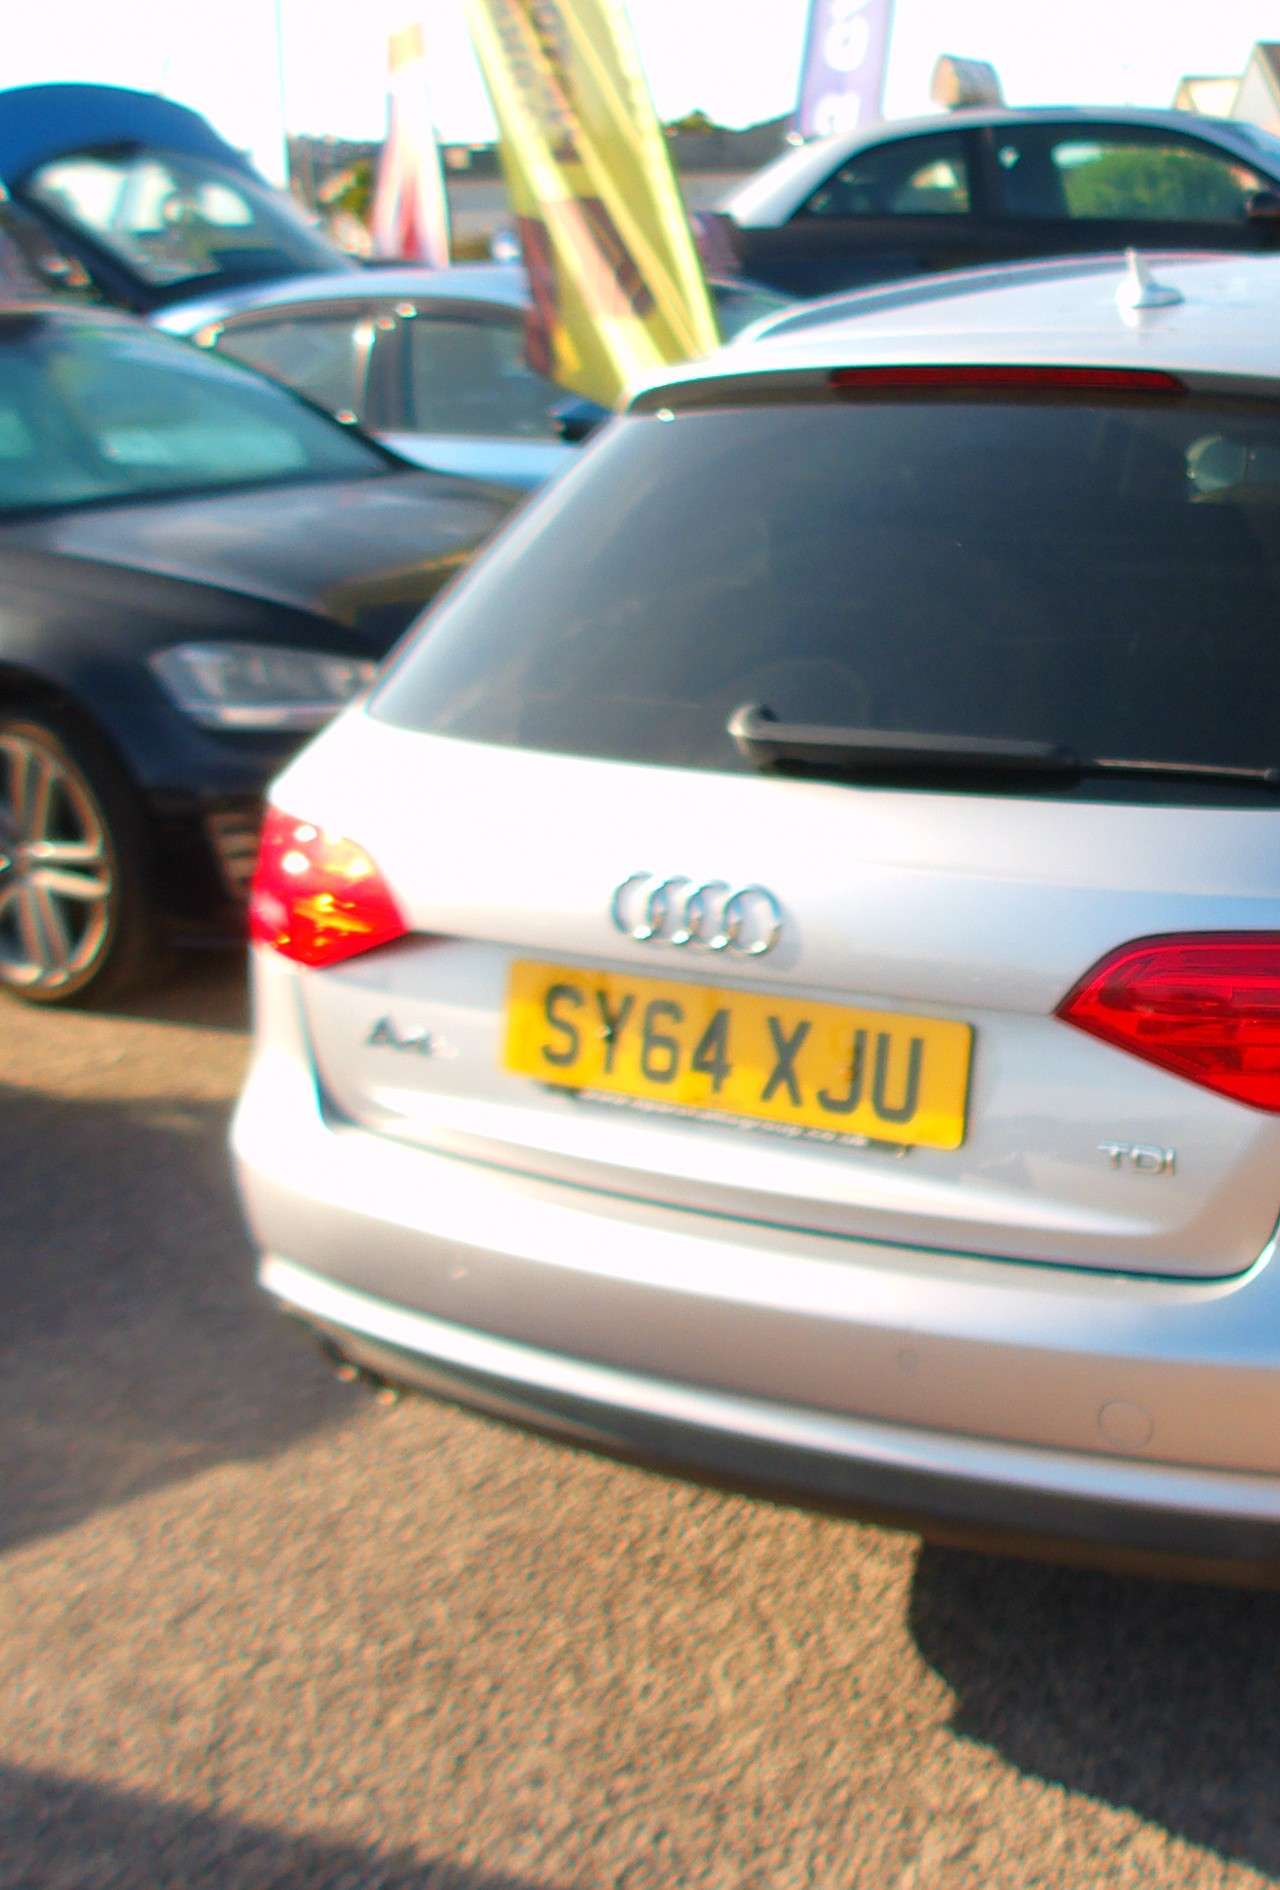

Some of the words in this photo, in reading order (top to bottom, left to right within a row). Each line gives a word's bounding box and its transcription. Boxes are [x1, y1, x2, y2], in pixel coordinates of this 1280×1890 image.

[541, 983, 732, 1095] SY64
[760, 1015, 924, 1123] XJU
[1096, 1142, 1176, 1177] TDI
